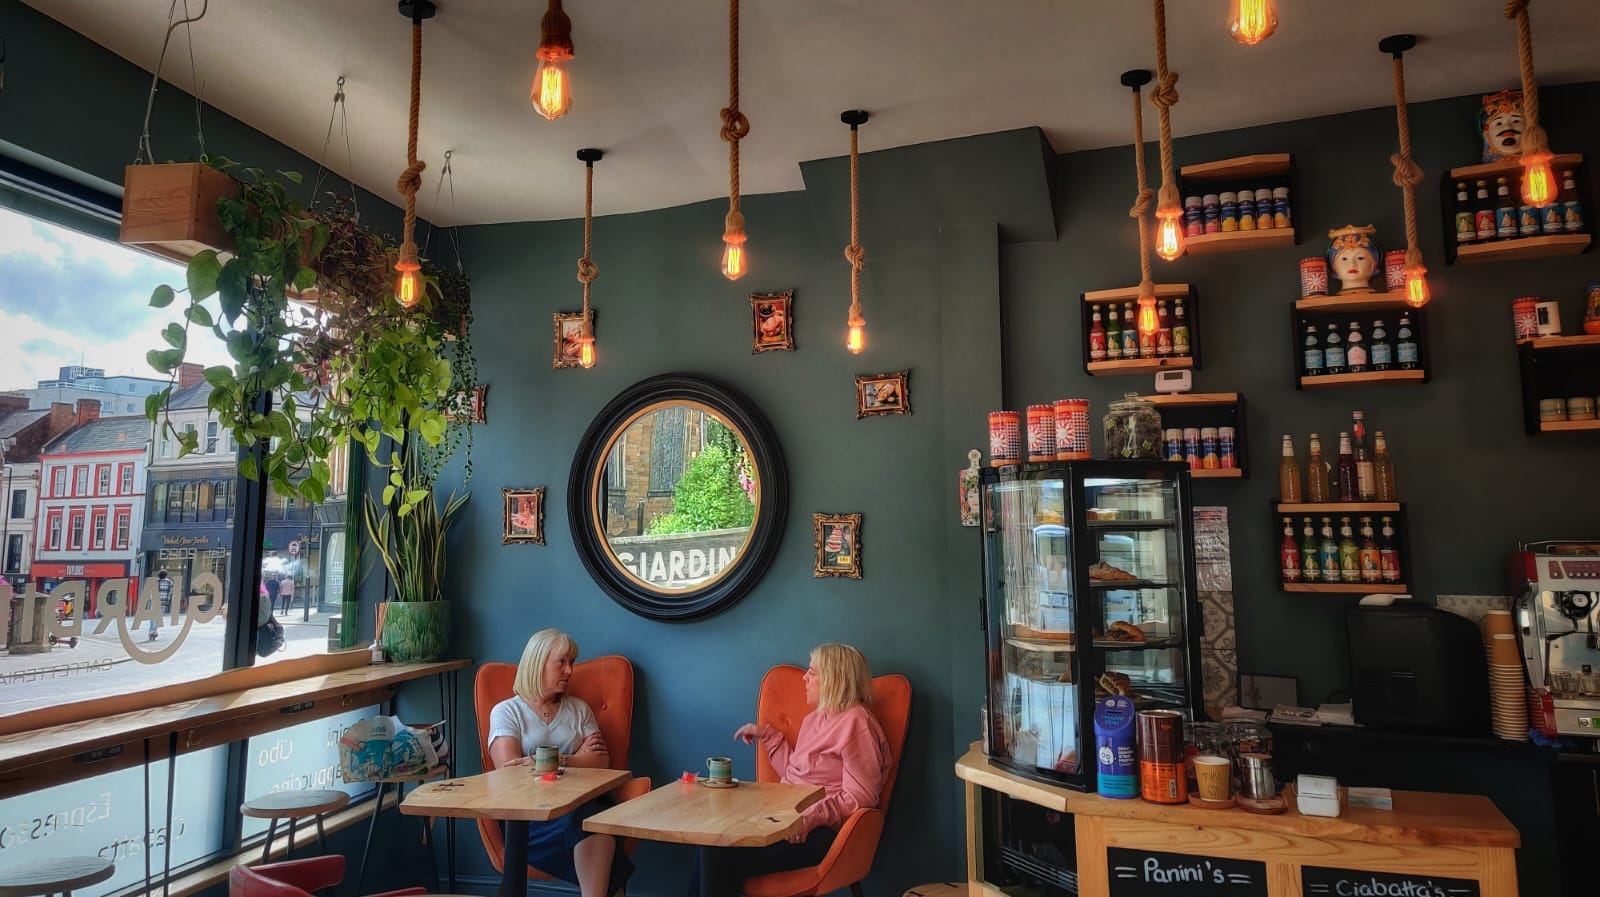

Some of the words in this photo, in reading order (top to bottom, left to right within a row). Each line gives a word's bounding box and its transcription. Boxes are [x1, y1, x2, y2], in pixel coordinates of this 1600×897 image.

[618, 546, 736, 587] GIARDIN
[1143, 857, 1226, 884] Panini's
[1335, 877, 1446, 897] Ciabatta's
